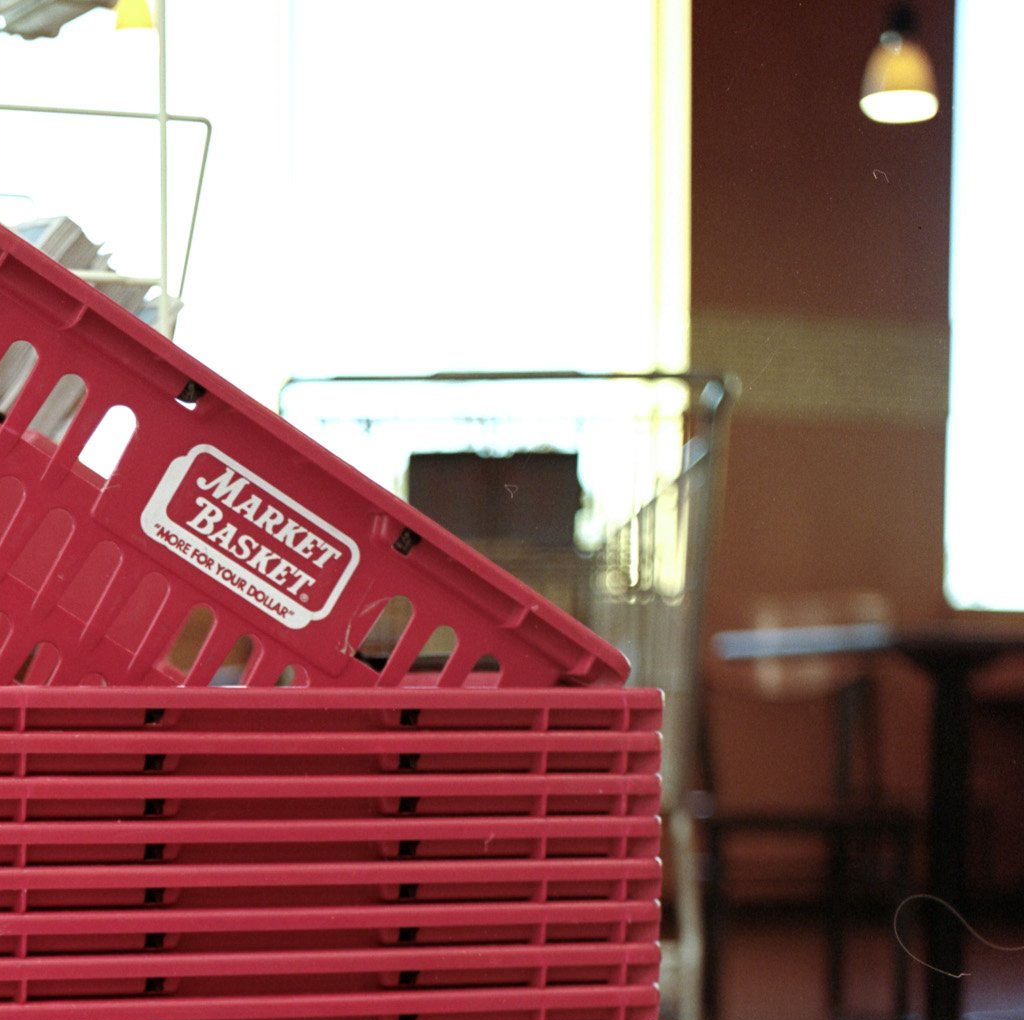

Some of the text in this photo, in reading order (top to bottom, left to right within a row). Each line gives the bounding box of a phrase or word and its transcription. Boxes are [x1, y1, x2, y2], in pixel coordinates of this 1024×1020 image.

[196, 467, 342, 569] MARKET
[154, 523, 296, 619] "MORE FOR YOUR DOLLAR"
